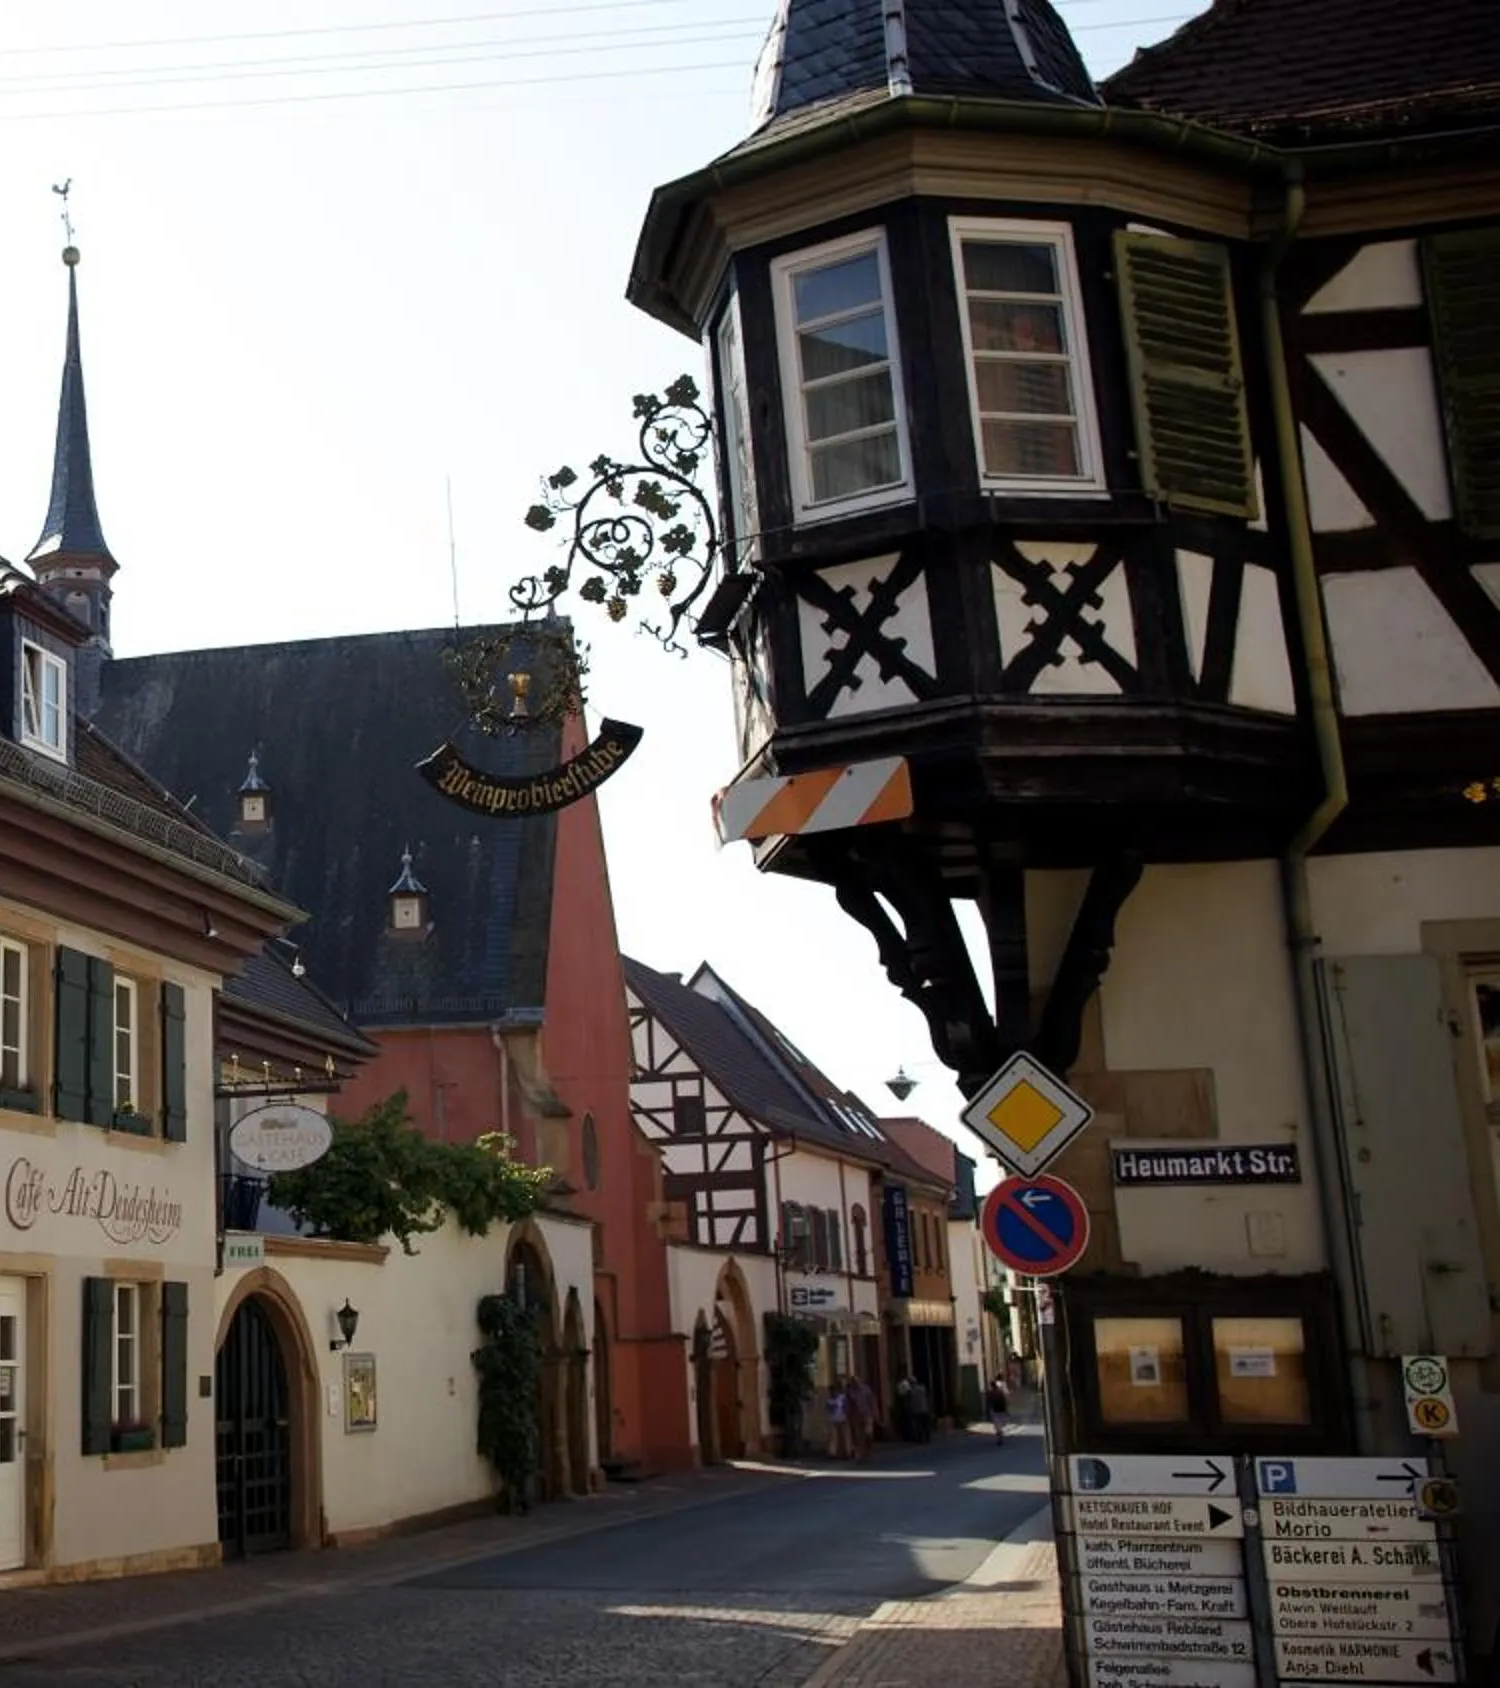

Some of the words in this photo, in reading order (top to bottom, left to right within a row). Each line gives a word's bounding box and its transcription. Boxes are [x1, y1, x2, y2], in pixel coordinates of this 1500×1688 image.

[1120, 1152, 1243, 1178] Heumarkt
[1248, 1149, 1295, 1175] Str.
[5, 1157, 47, 1231] Café
[1423, 1405, 1441, 1423] K
[1267, 1465, 1287, 1490] P
[1153, 1501, 1173, 1515] HOF
[1273, 1502, 1417, 1518] Bildhaueratelier
[1080, 1517, 1108, 1531] Hotel
[1111, 1518, 1172, 1532] Restaurant
[1174, 1519, 1204, 1532] Event
[1275, 1520, 1332, 1537] Morio
[1118, 1539, 1203, 1553] Pfarrzentrum
[1272, 1545, 1346, 1565] Bäckerei
[1351, 1546, 1368, 1565] A.
[1133, 1556, 1192, 1571] Bücherei
[1088, 1579, 1151, 1594] Gasthaus
[1167, 1581, 1233, 1596] Metzgerei
[1276, 1586, 1409, 1600] Obstbrennerei
[1201, 1600, 1236, 1613] Kraft
[1279, 1602, 1315, 1614] Alwin
[1279, 1618, 1317, 1630] Obere
[1231, 1642, 1246, 1655] 12
[1340, 1643, 1400, 1659] HARMONIE
[1285, 1660, 1319, 1676] Anja
[1325, 1661, 1365, 1676] Diehl
